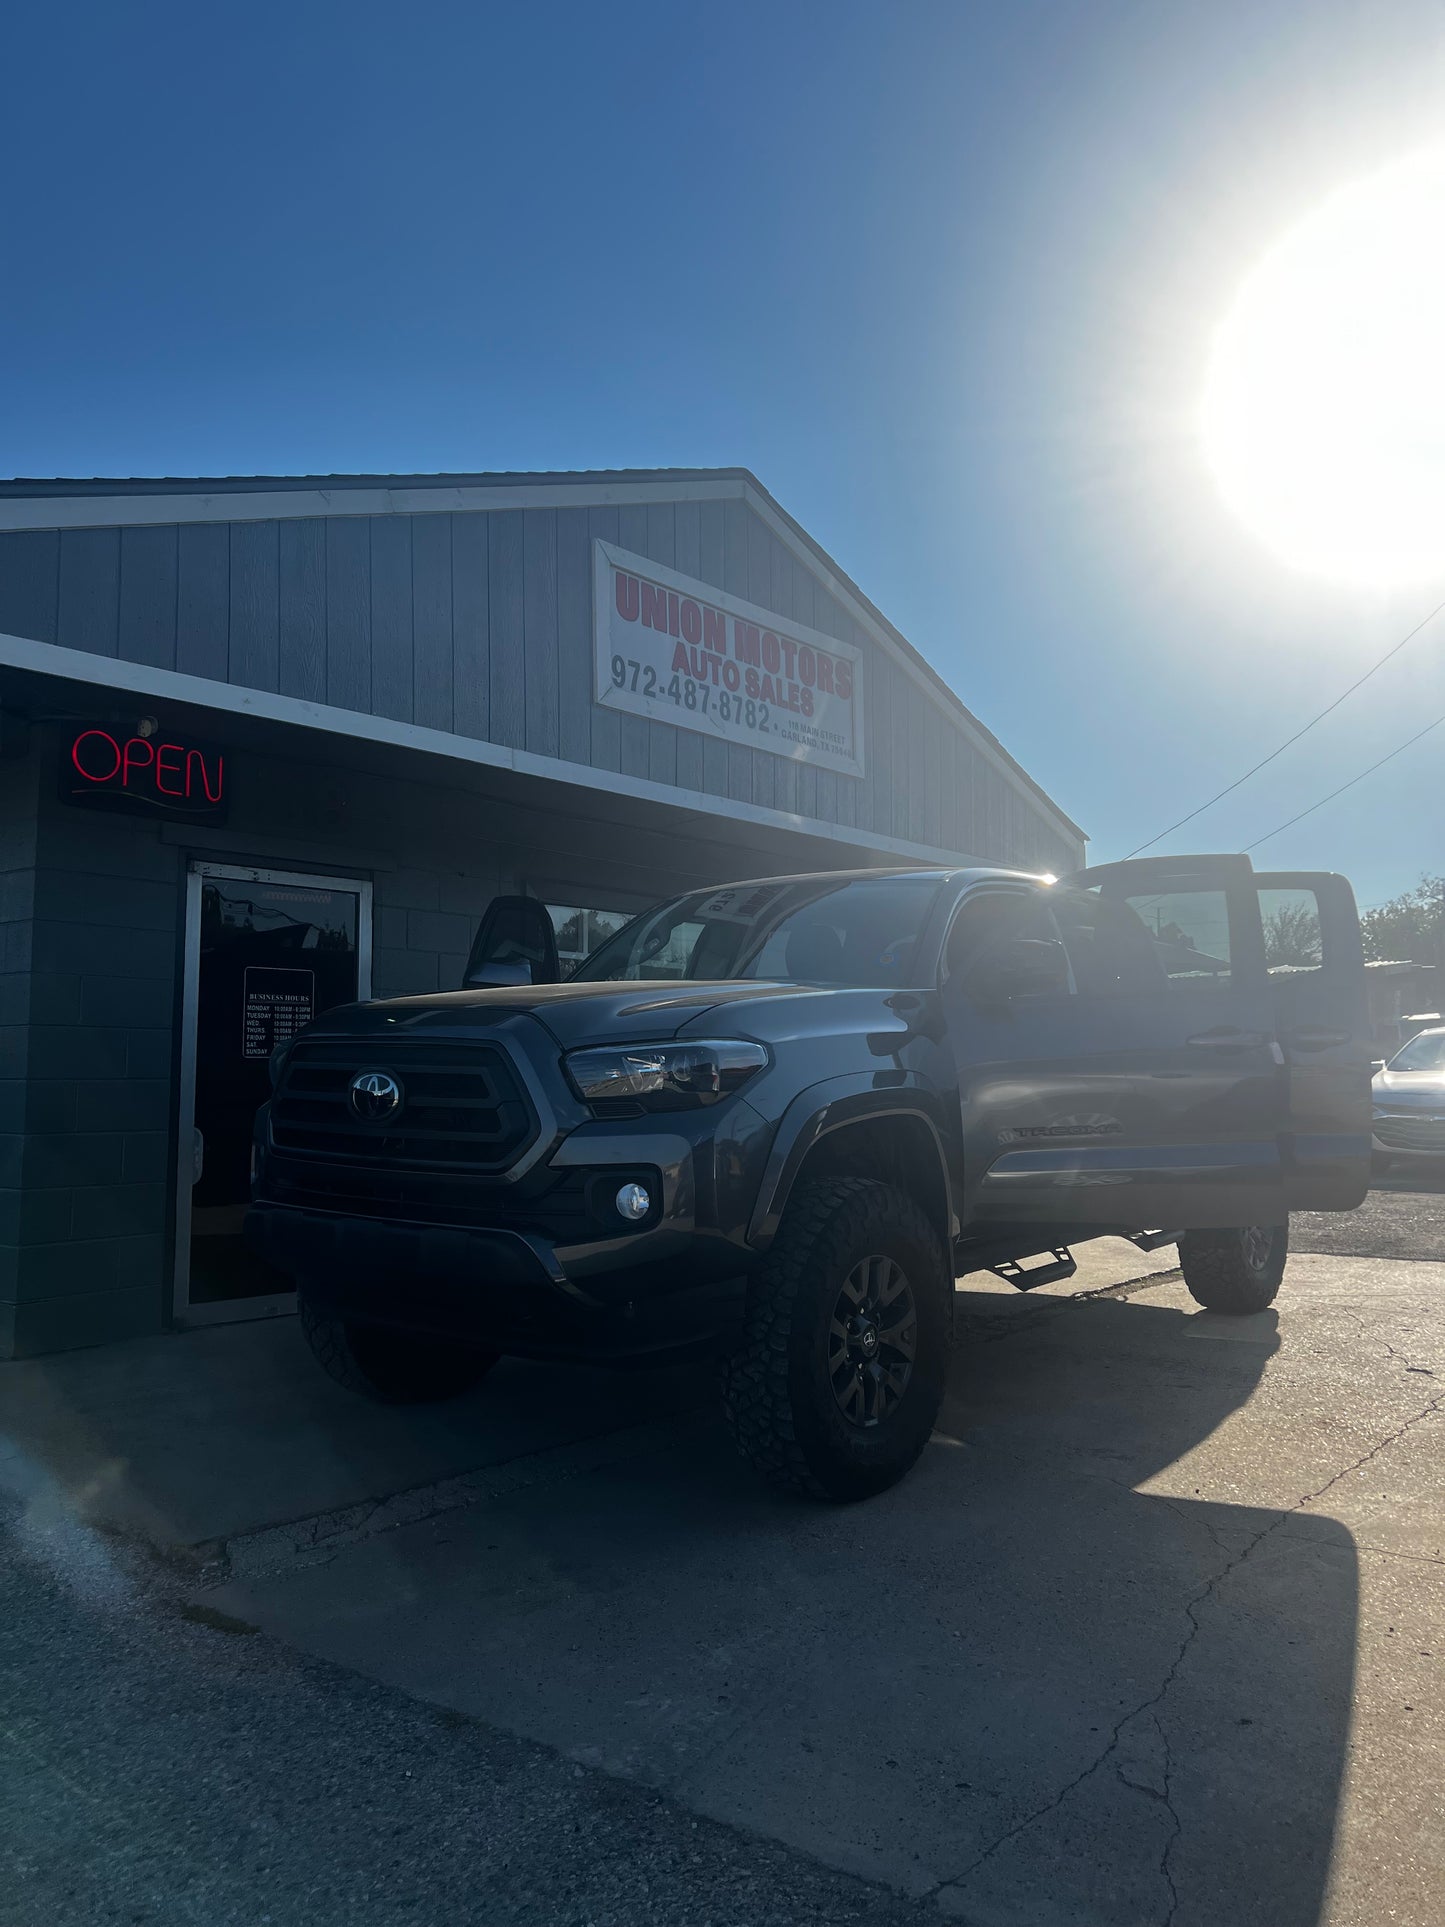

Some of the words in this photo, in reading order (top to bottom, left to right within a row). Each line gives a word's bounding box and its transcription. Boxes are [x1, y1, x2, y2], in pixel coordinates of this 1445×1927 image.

[615, 571, 727, 656] UNION
[734, 619, 853, 700] MOTORS
[611, 654, 771, 733] 972-487-8782
[671, 641, 741, 692] AUTO
[744, 667, 815, 718] SALES
[71, 729, 224, 803] OPEN
[800, 723, 819, 738] MAIN
[820, 729, 846, 745] STREET
[821, 741, 830, 752] TX
[1012, 1123, 1124, 1137] TACOMA
